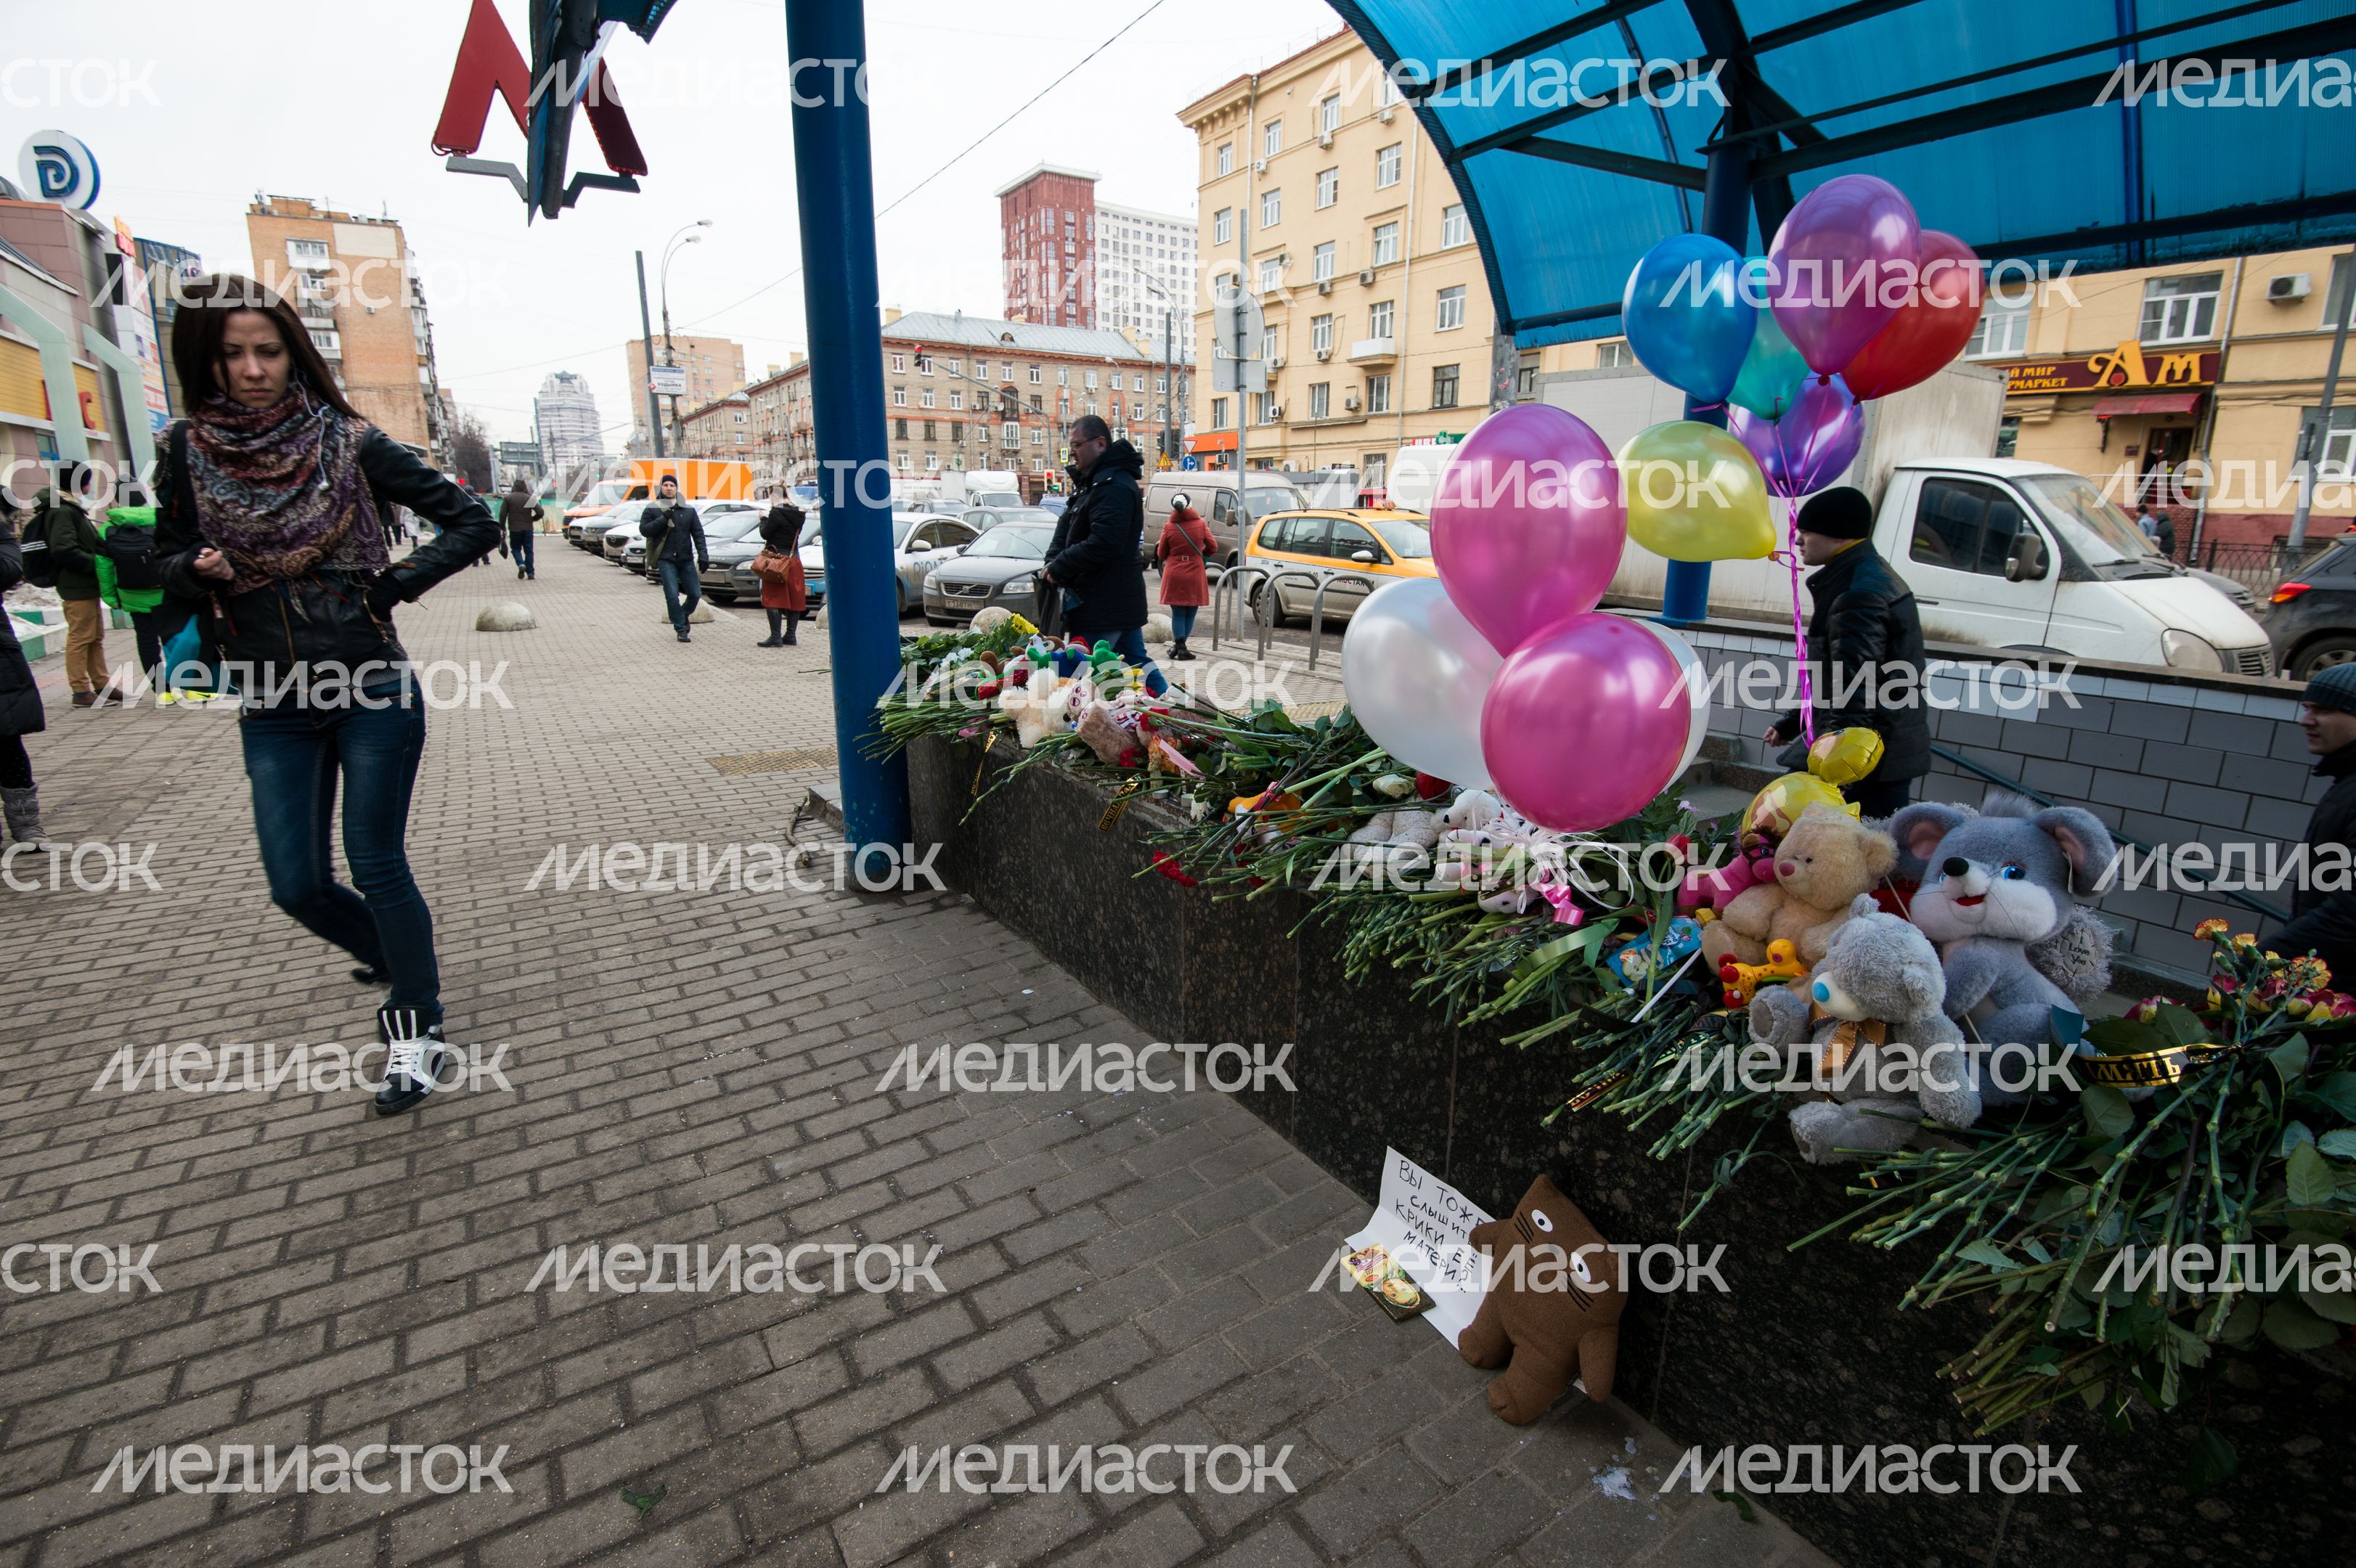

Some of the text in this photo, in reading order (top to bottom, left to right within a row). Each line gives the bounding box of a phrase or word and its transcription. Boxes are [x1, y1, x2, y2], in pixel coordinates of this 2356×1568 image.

[2023, 366, 2056, 377] МИР
[2068, 942, 2090, 955] Love
[2071, 954, 2087, 965] You
[1399, 1159, 1423, 1191] ВЫ
[1395, 1198, 1445, 1246] КРИКИ
